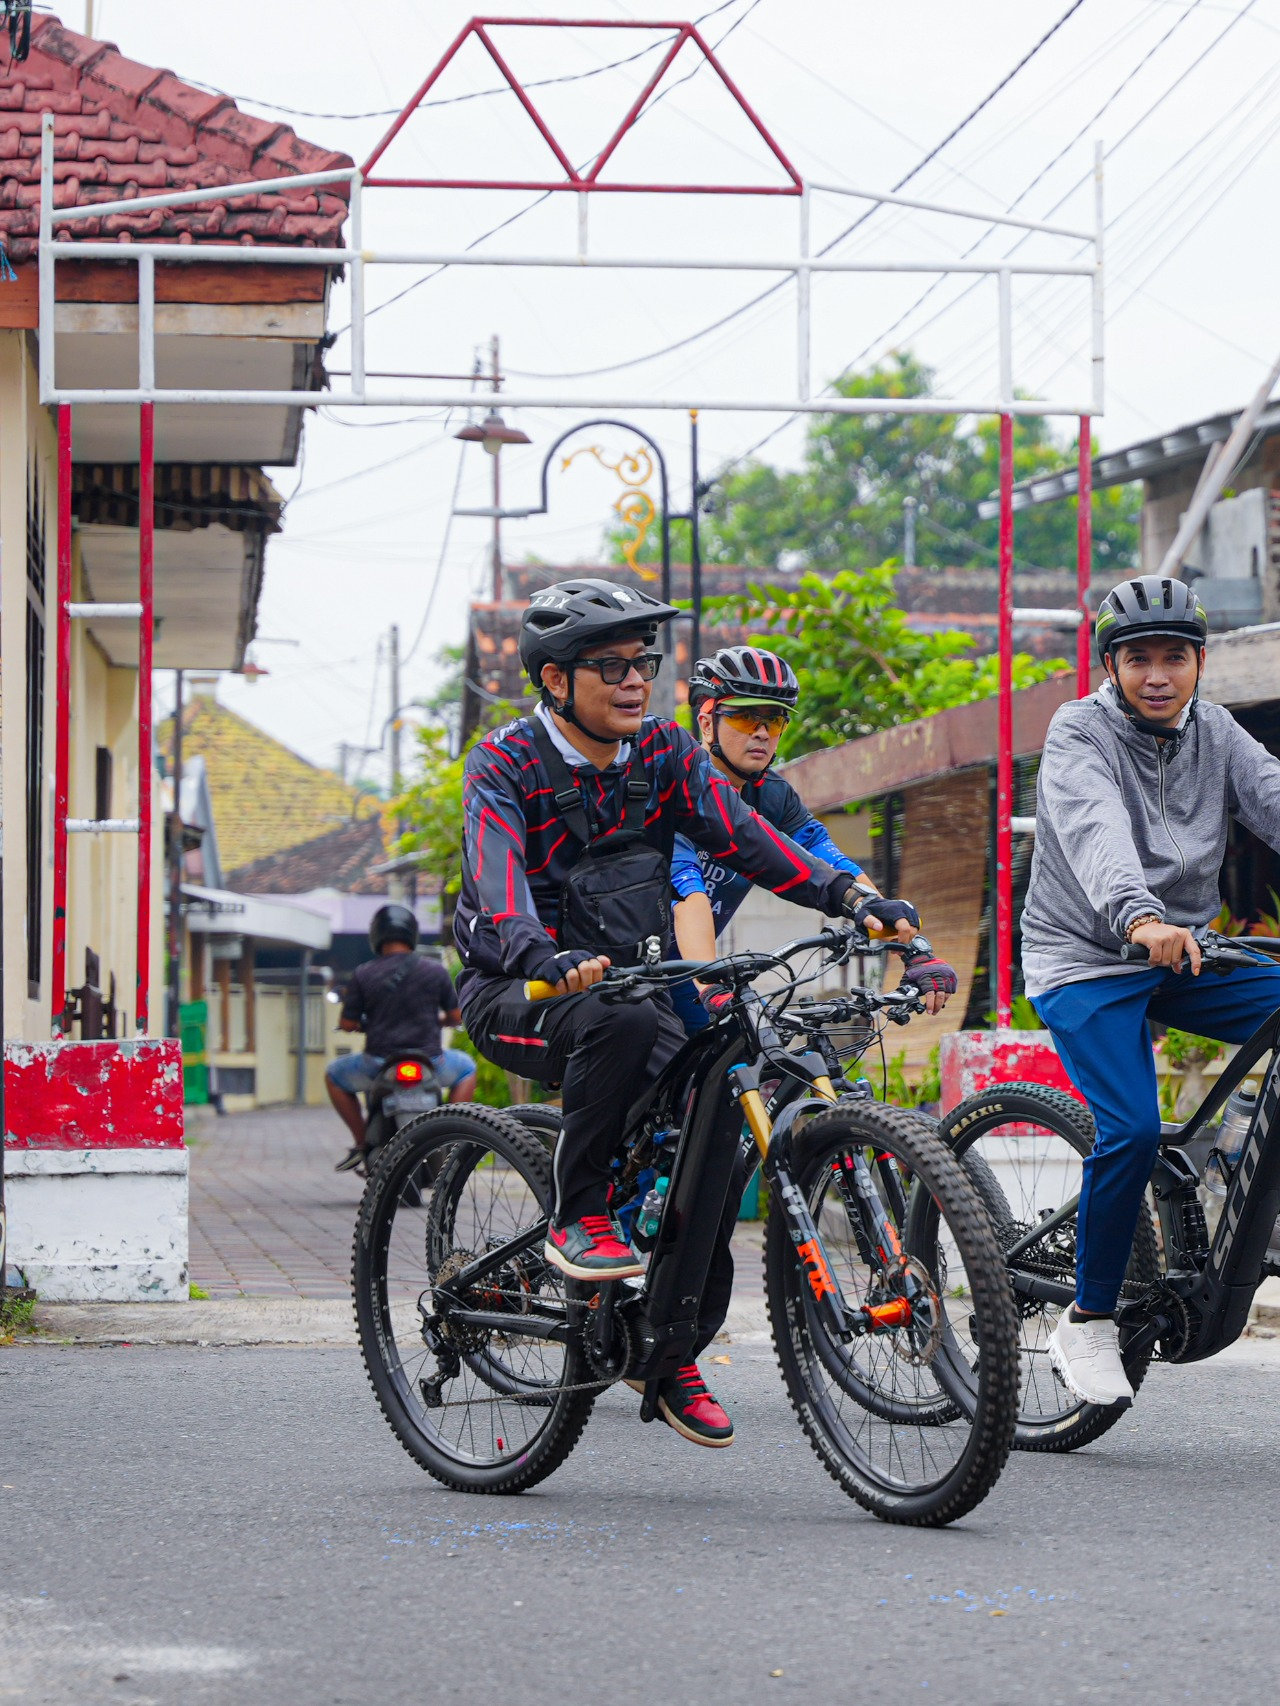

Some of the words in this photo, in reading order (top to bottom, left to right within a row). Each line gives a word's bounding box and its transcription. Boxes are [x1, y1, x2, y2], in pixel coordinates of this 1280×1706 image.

[949, 1104, 1004, 1138] MAXXIS
[797, 1238, 837, 1302] FOX
[790, 1327, 810, 1377] SUN
[800, 1403, 842, 1467] MAGIC
[840, 1467, 886, 1503] MARY
